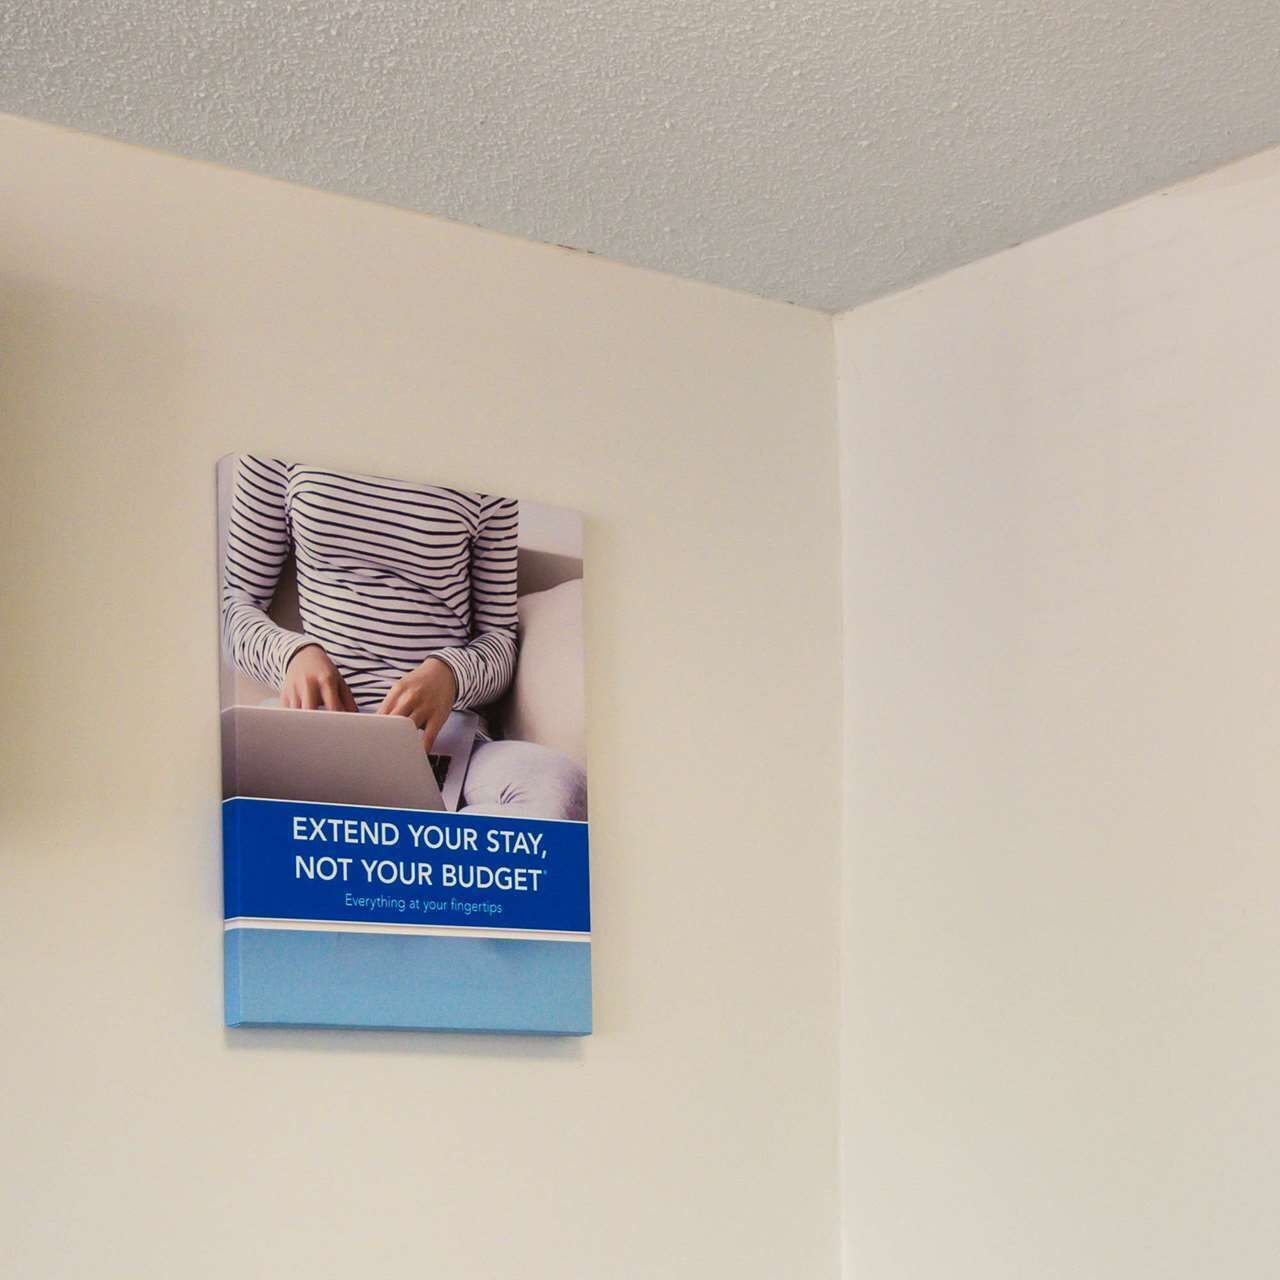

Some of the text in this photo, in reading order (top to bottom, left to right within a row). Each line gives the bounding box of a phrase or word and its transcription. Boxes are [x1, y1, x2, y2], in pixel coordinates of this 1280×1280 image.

[293, 816, 547, 859] EXTEND YOUR STAY,
[295, 856, 353, 881] NOT
[361, 859, 433, 886] YOUR
[345, 893, 503, 915] Everything at your fingertips
